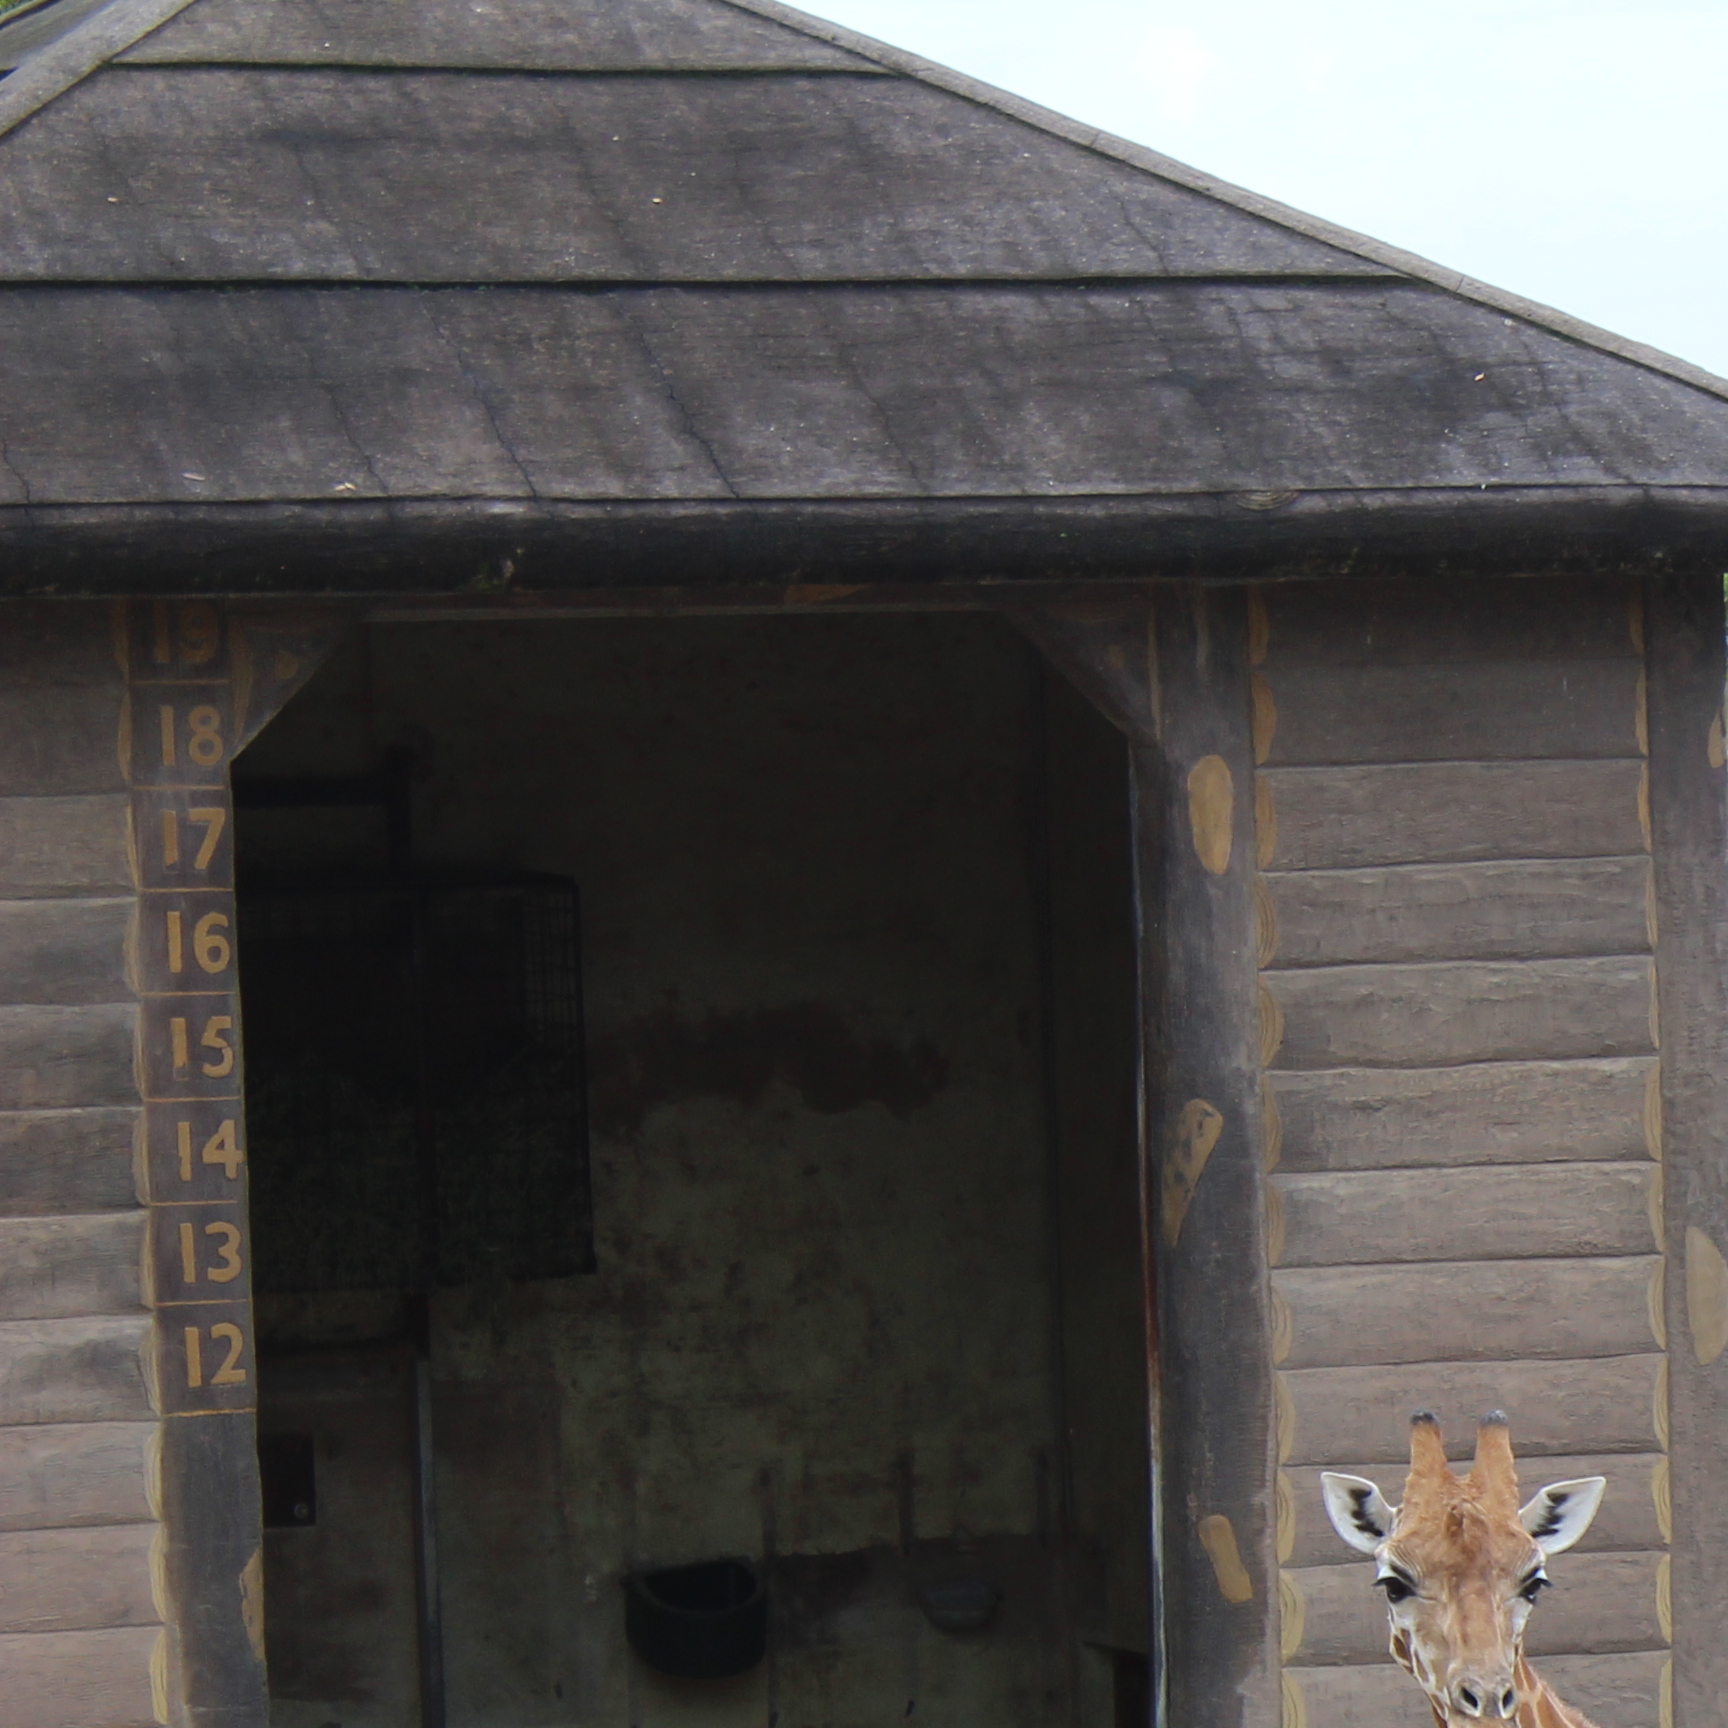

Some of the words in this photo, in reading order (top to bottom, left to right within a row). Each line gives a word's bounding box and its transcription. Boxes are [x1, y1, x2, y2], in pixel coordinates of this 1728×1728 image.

[153, 600, 219, 664] 19
[160, 705, 225, 767] 18
[163, 808, 226, 871] 17
[167, 911, 231, 975] 16
[170, 1015, 235, 1079] 15
[176, 1119, 244, 1182] 14
[178, 1221, 243, 1284] 13
[183, 1322, 247, 1388] 12
